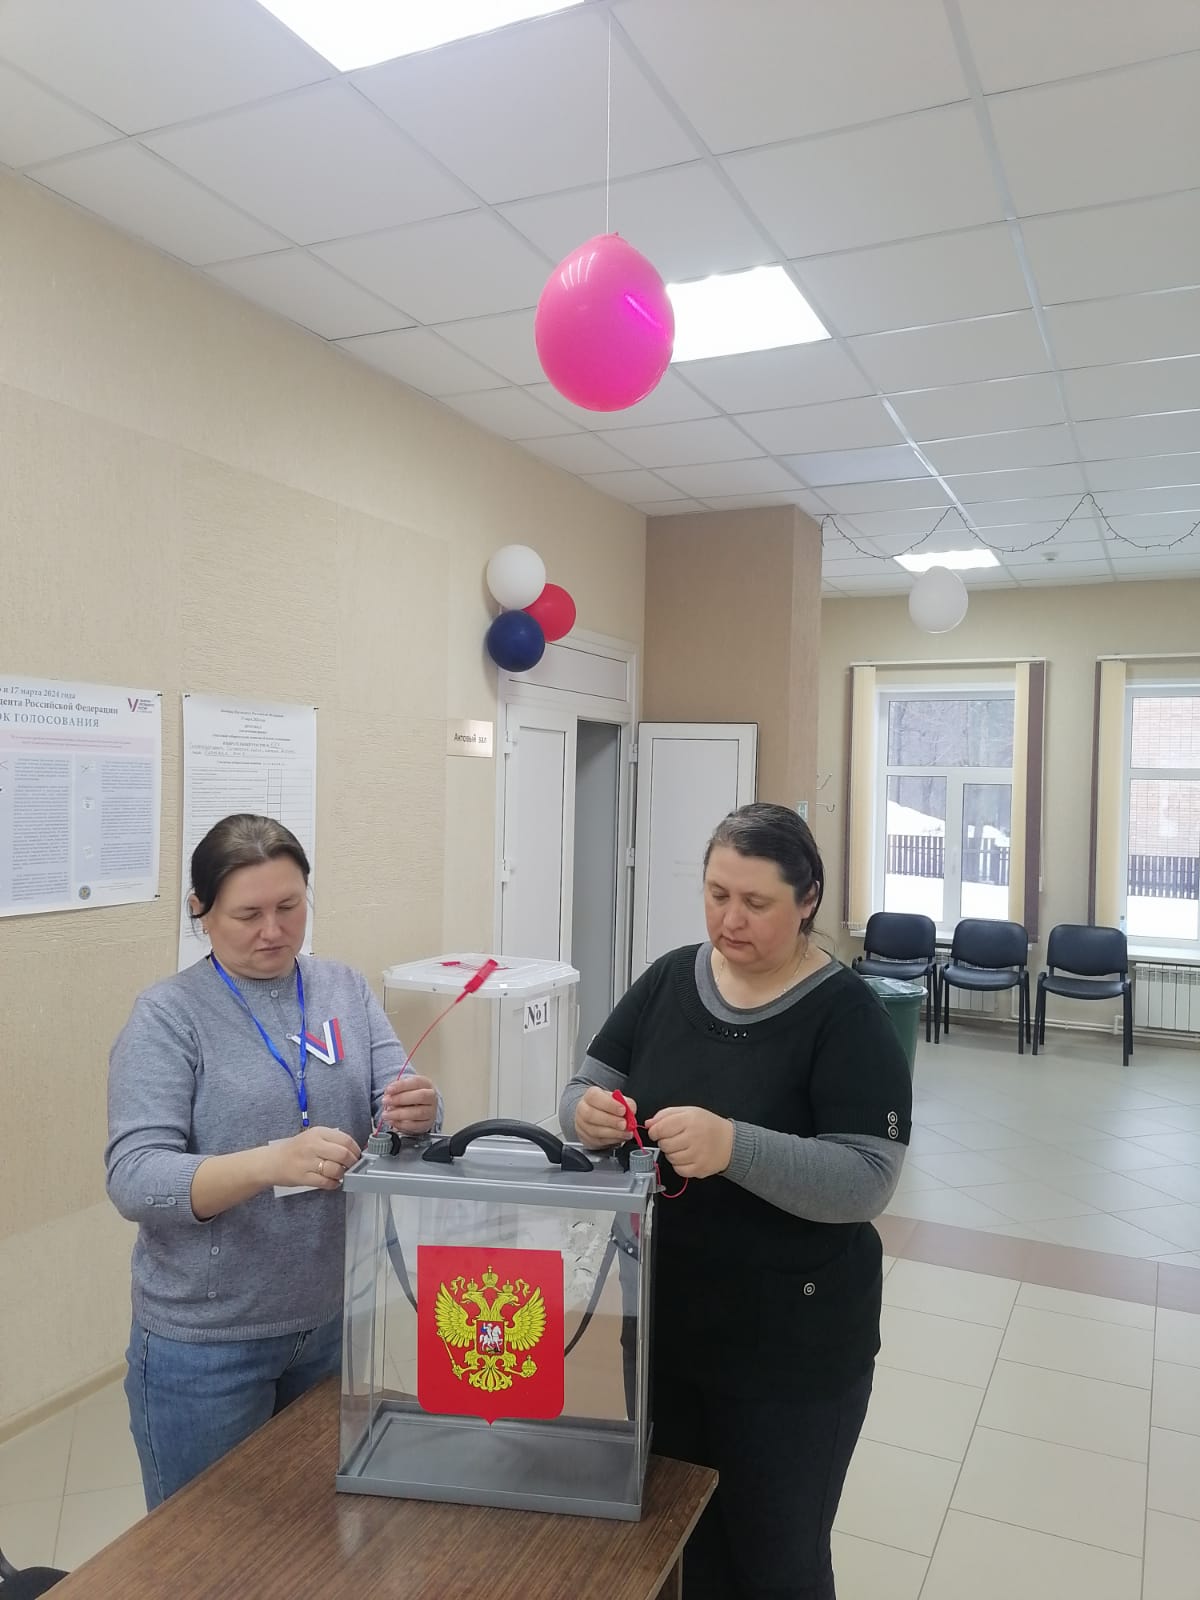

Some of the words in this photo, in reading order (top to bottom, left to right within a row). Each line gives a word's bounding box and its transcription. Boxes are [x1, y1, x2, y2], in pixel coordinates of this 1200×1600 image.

[11, 686, 19, 694] 17
[21, 689, 42, 697] марта
[43, 690, 60, 698] 2024
[25, 698, 73, 710] Российской
[75, 702, 119, 715] Федерации
[15, 712, 99, 728] ГОЛОСОВАНИЯ
[454, 732, 477, 743] Актовый
[527, 1001, 548, 1026] №1
